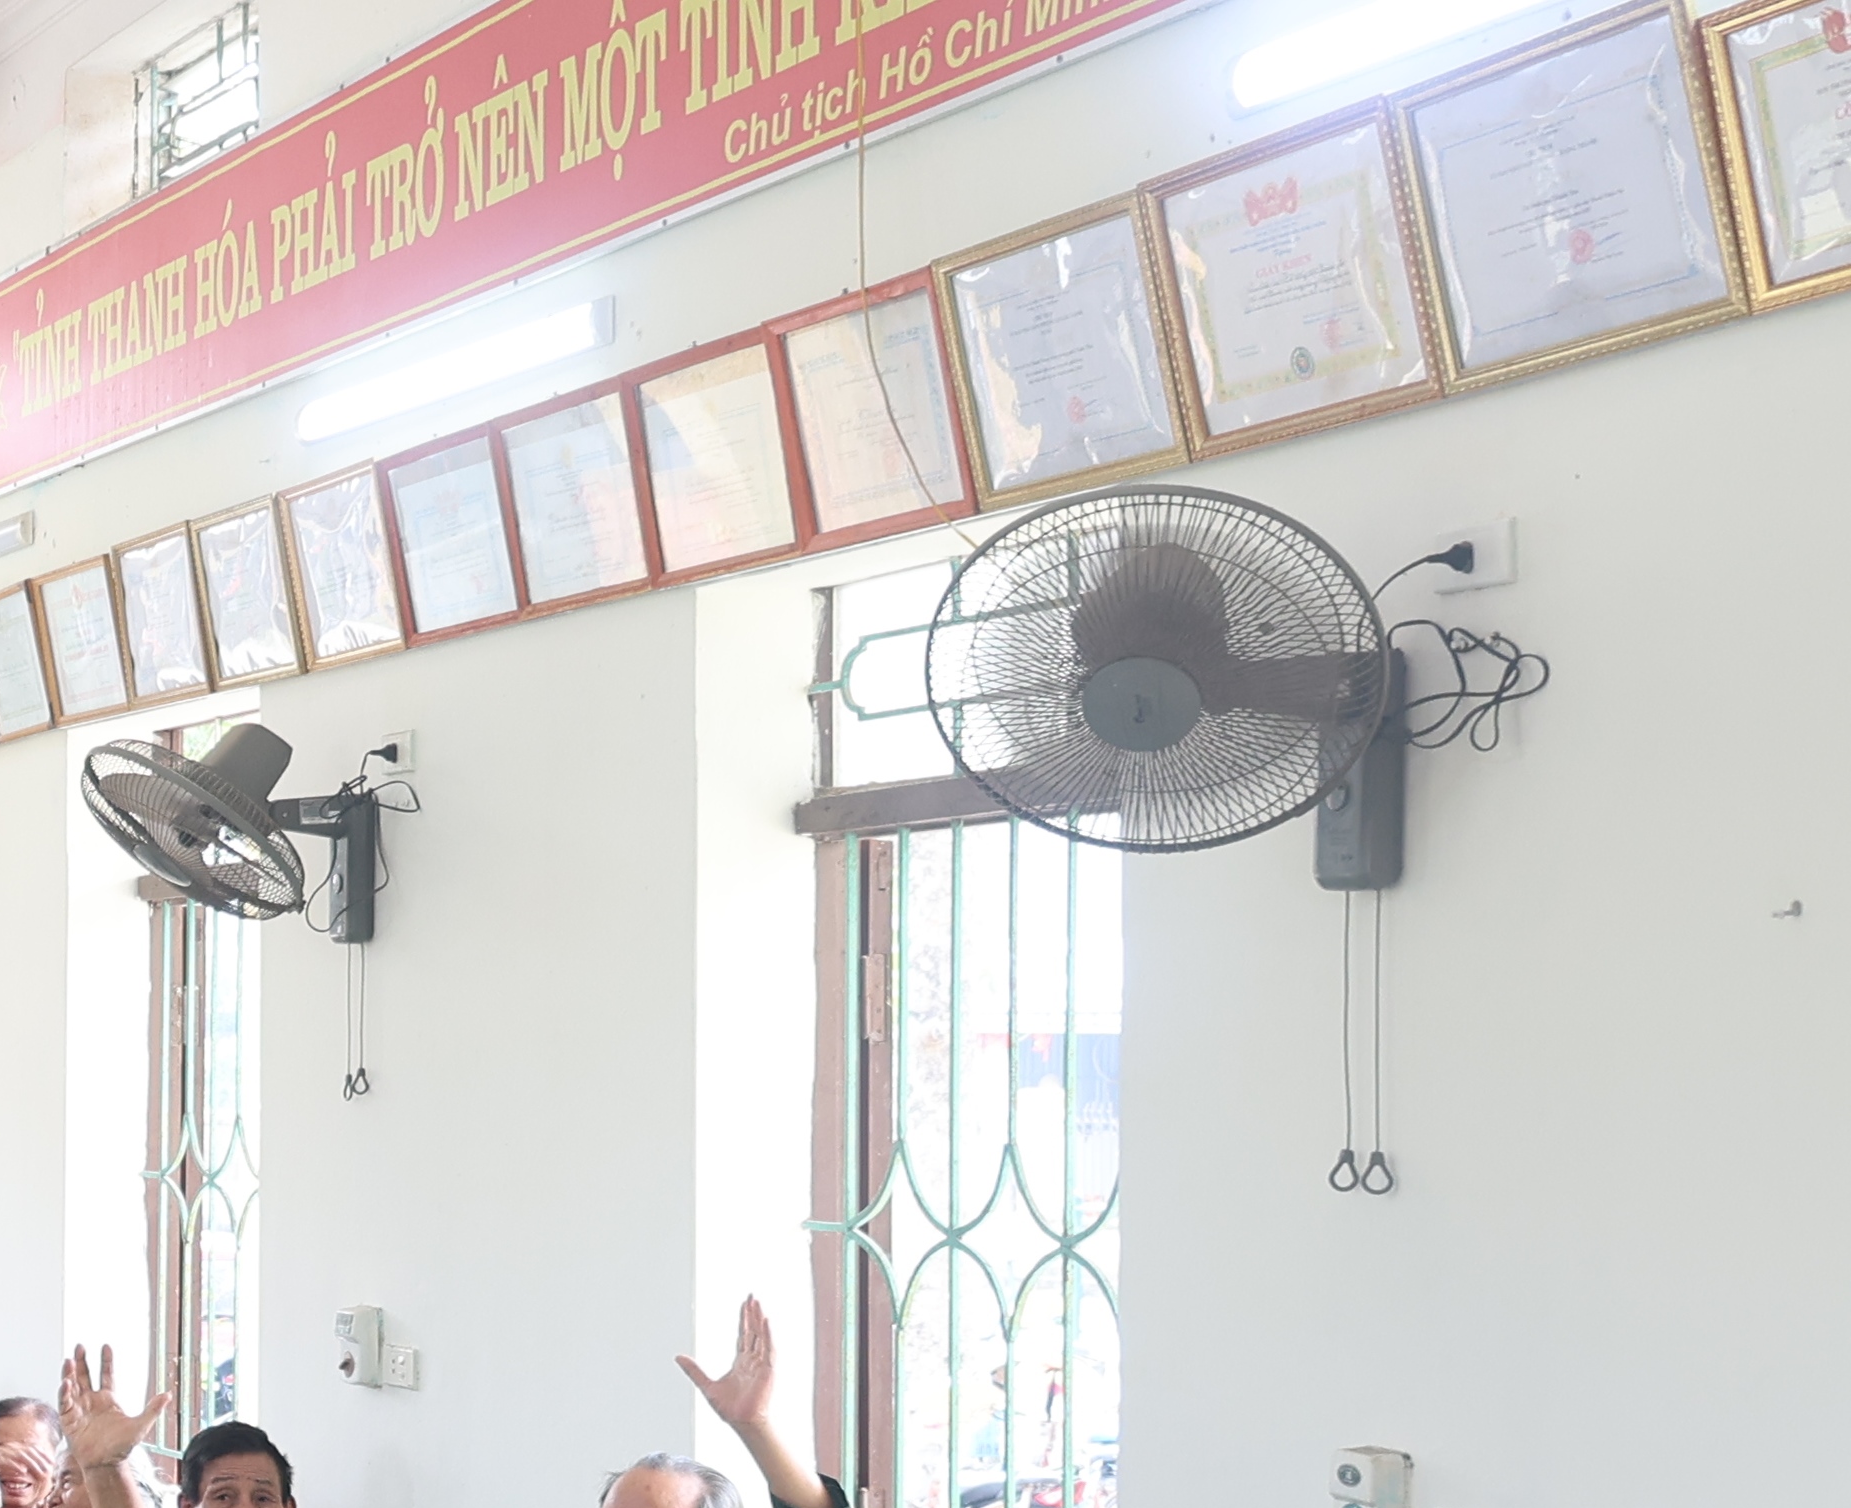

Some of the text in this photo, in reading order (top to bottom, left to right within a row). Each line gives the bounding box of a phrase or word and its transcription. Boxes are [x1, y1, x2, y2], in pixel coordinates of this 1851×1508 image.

[87, 254, 188, 386] THANH
[194, 198, 263, 340] HÓA
[270, 130, 357, 305] PHẢI
[365, 75, 445, 261] TRỞ
[454, 54, 549, 223] NÊN
[559, 0, 668, 182] MỘT
[724, 93, 793, 165] Chủ
[801, 68, 867, 139] tịch
[879, 27, 934, 100] Hồ
[944, 0, 1013, 68] Chí
